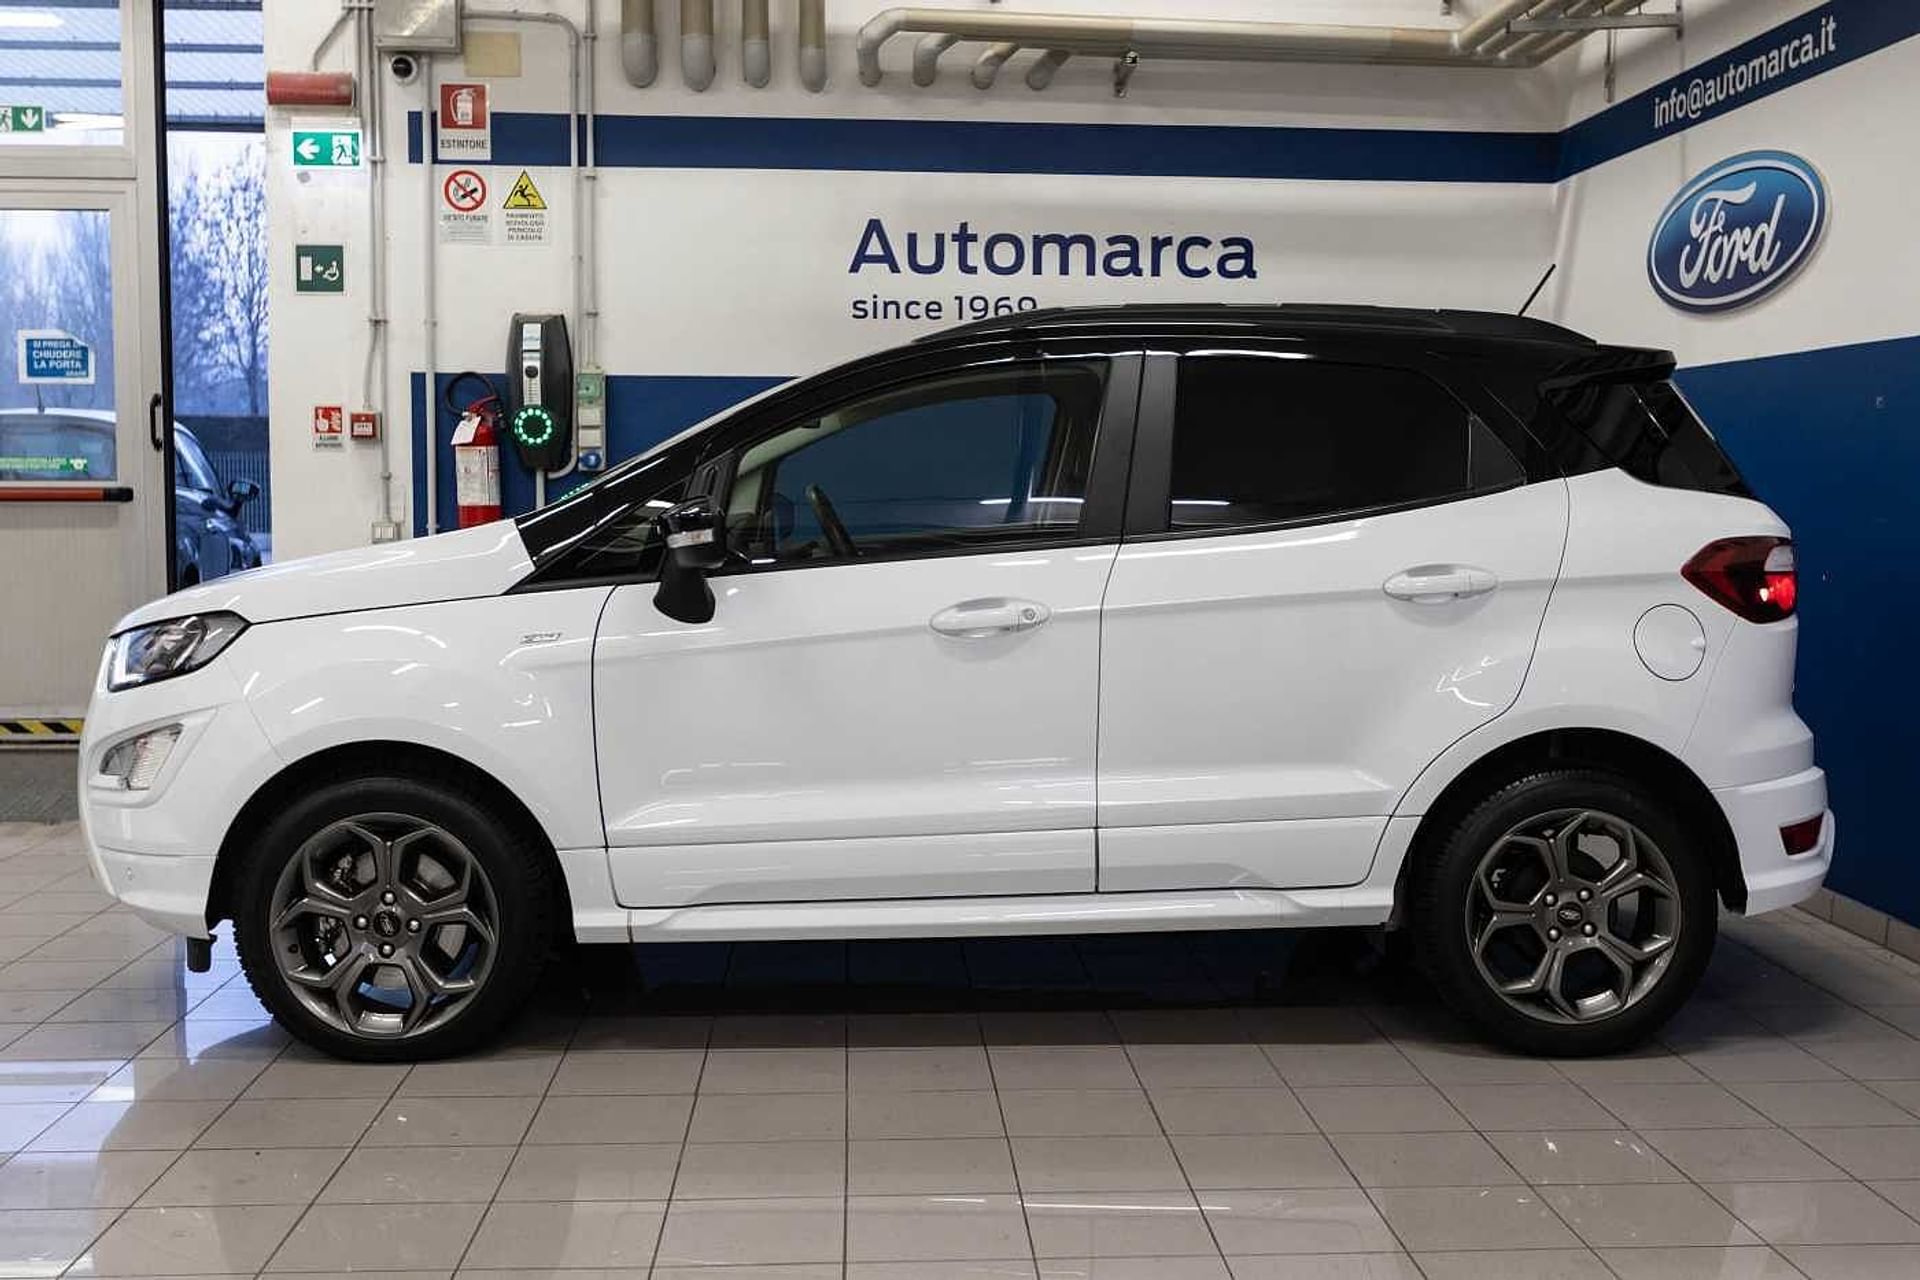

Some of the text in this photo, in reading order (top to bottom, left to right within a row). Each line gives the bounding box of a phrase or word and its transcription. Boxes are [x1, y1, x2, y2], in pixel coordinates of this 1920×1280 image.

[1654, 15, 1836, 128] info@automarca.it
[440, 138, 488, 149] ESTINTORE
[1679, 181, 1785, 288] Ford
[848, 219, 1257, 278] Automarca
[852, 294, 1037, 320] since 1969
[32, 350, 83, 359] CHIUDERE
[33, 360, 82, 369] LA PORTA
